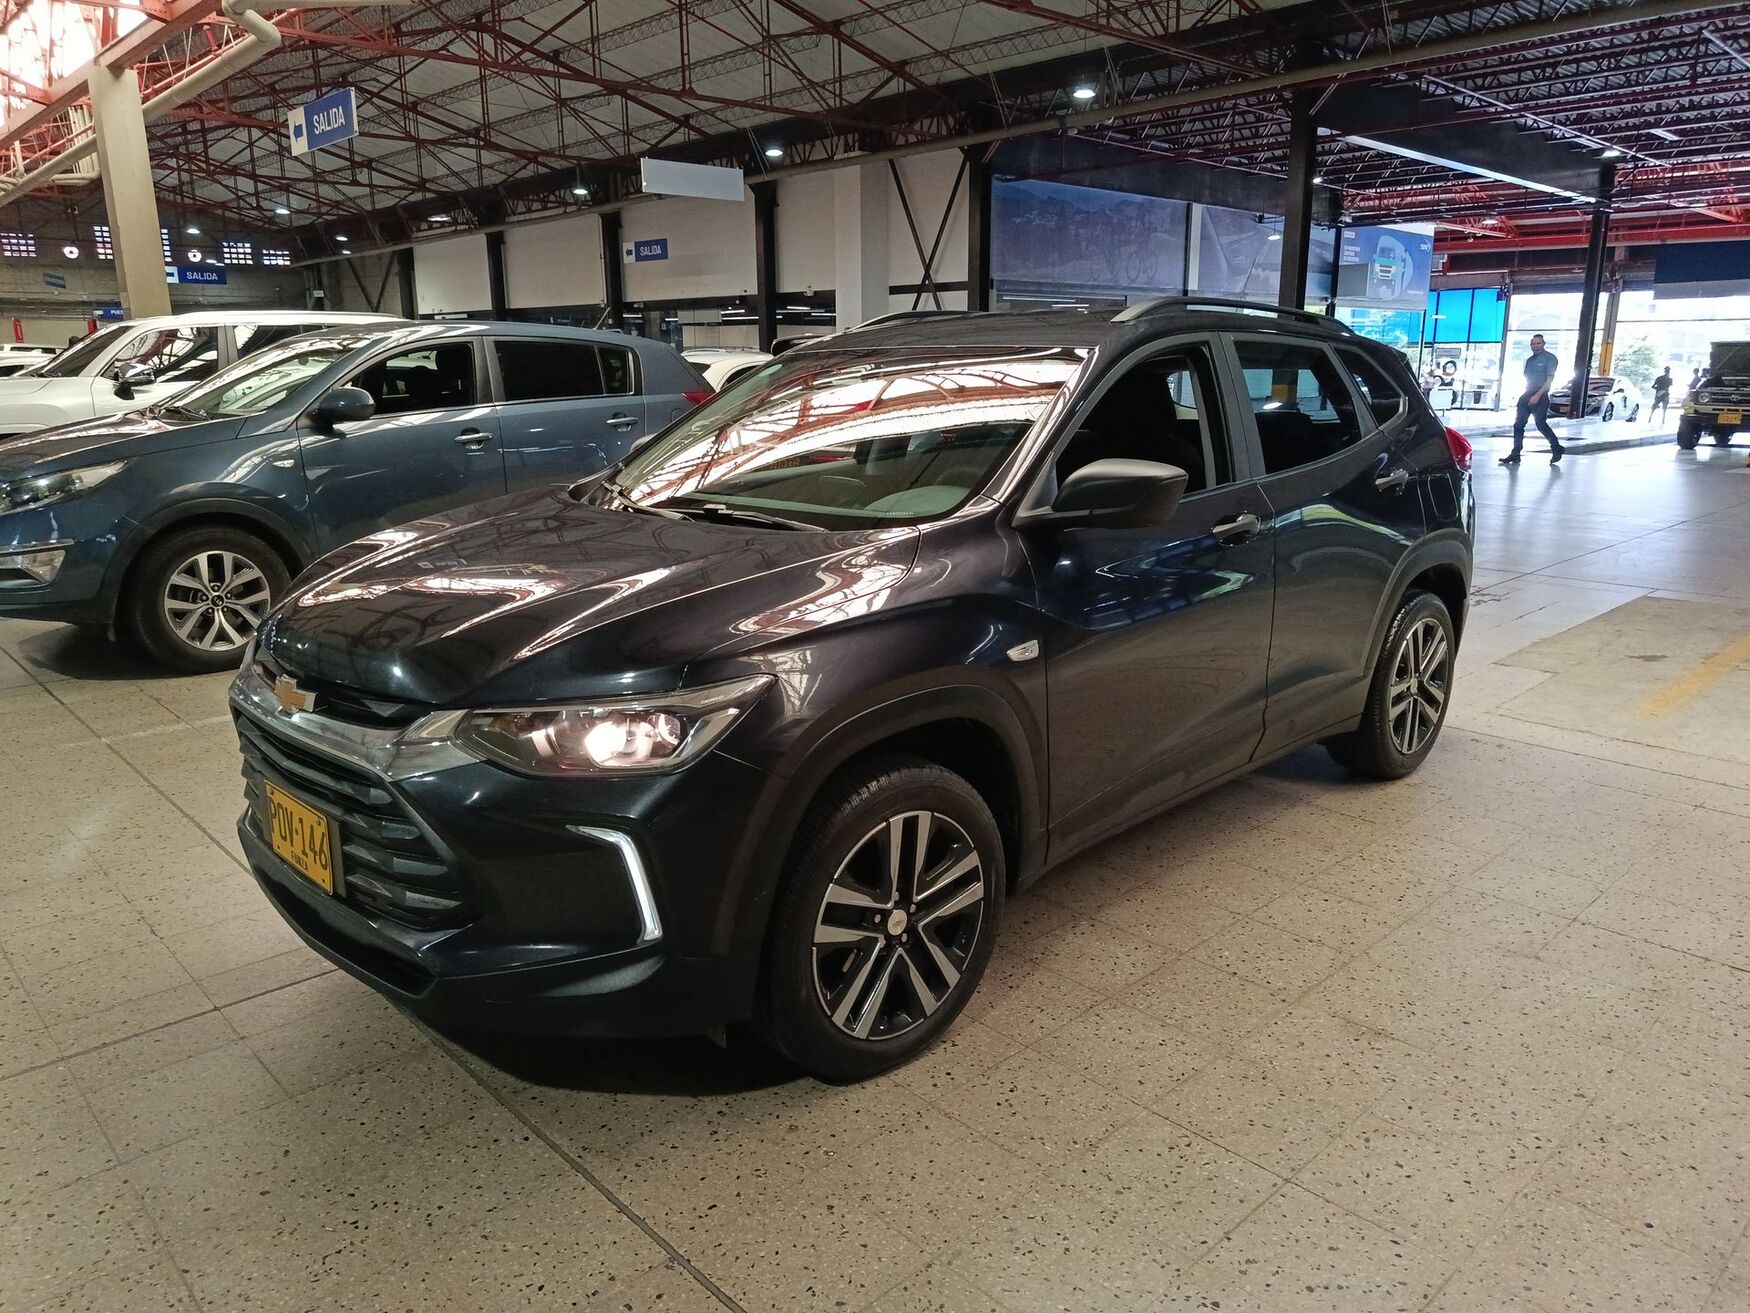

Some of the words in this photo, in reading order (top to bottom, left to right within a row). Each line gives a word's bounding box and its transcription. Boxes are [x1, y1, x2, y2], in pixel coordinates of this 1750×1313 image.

[313, 105, 346, 135] SALIDA
[639, 244, 662, 257] SALIDA
[186, 271, 218, 281] SALIDA
